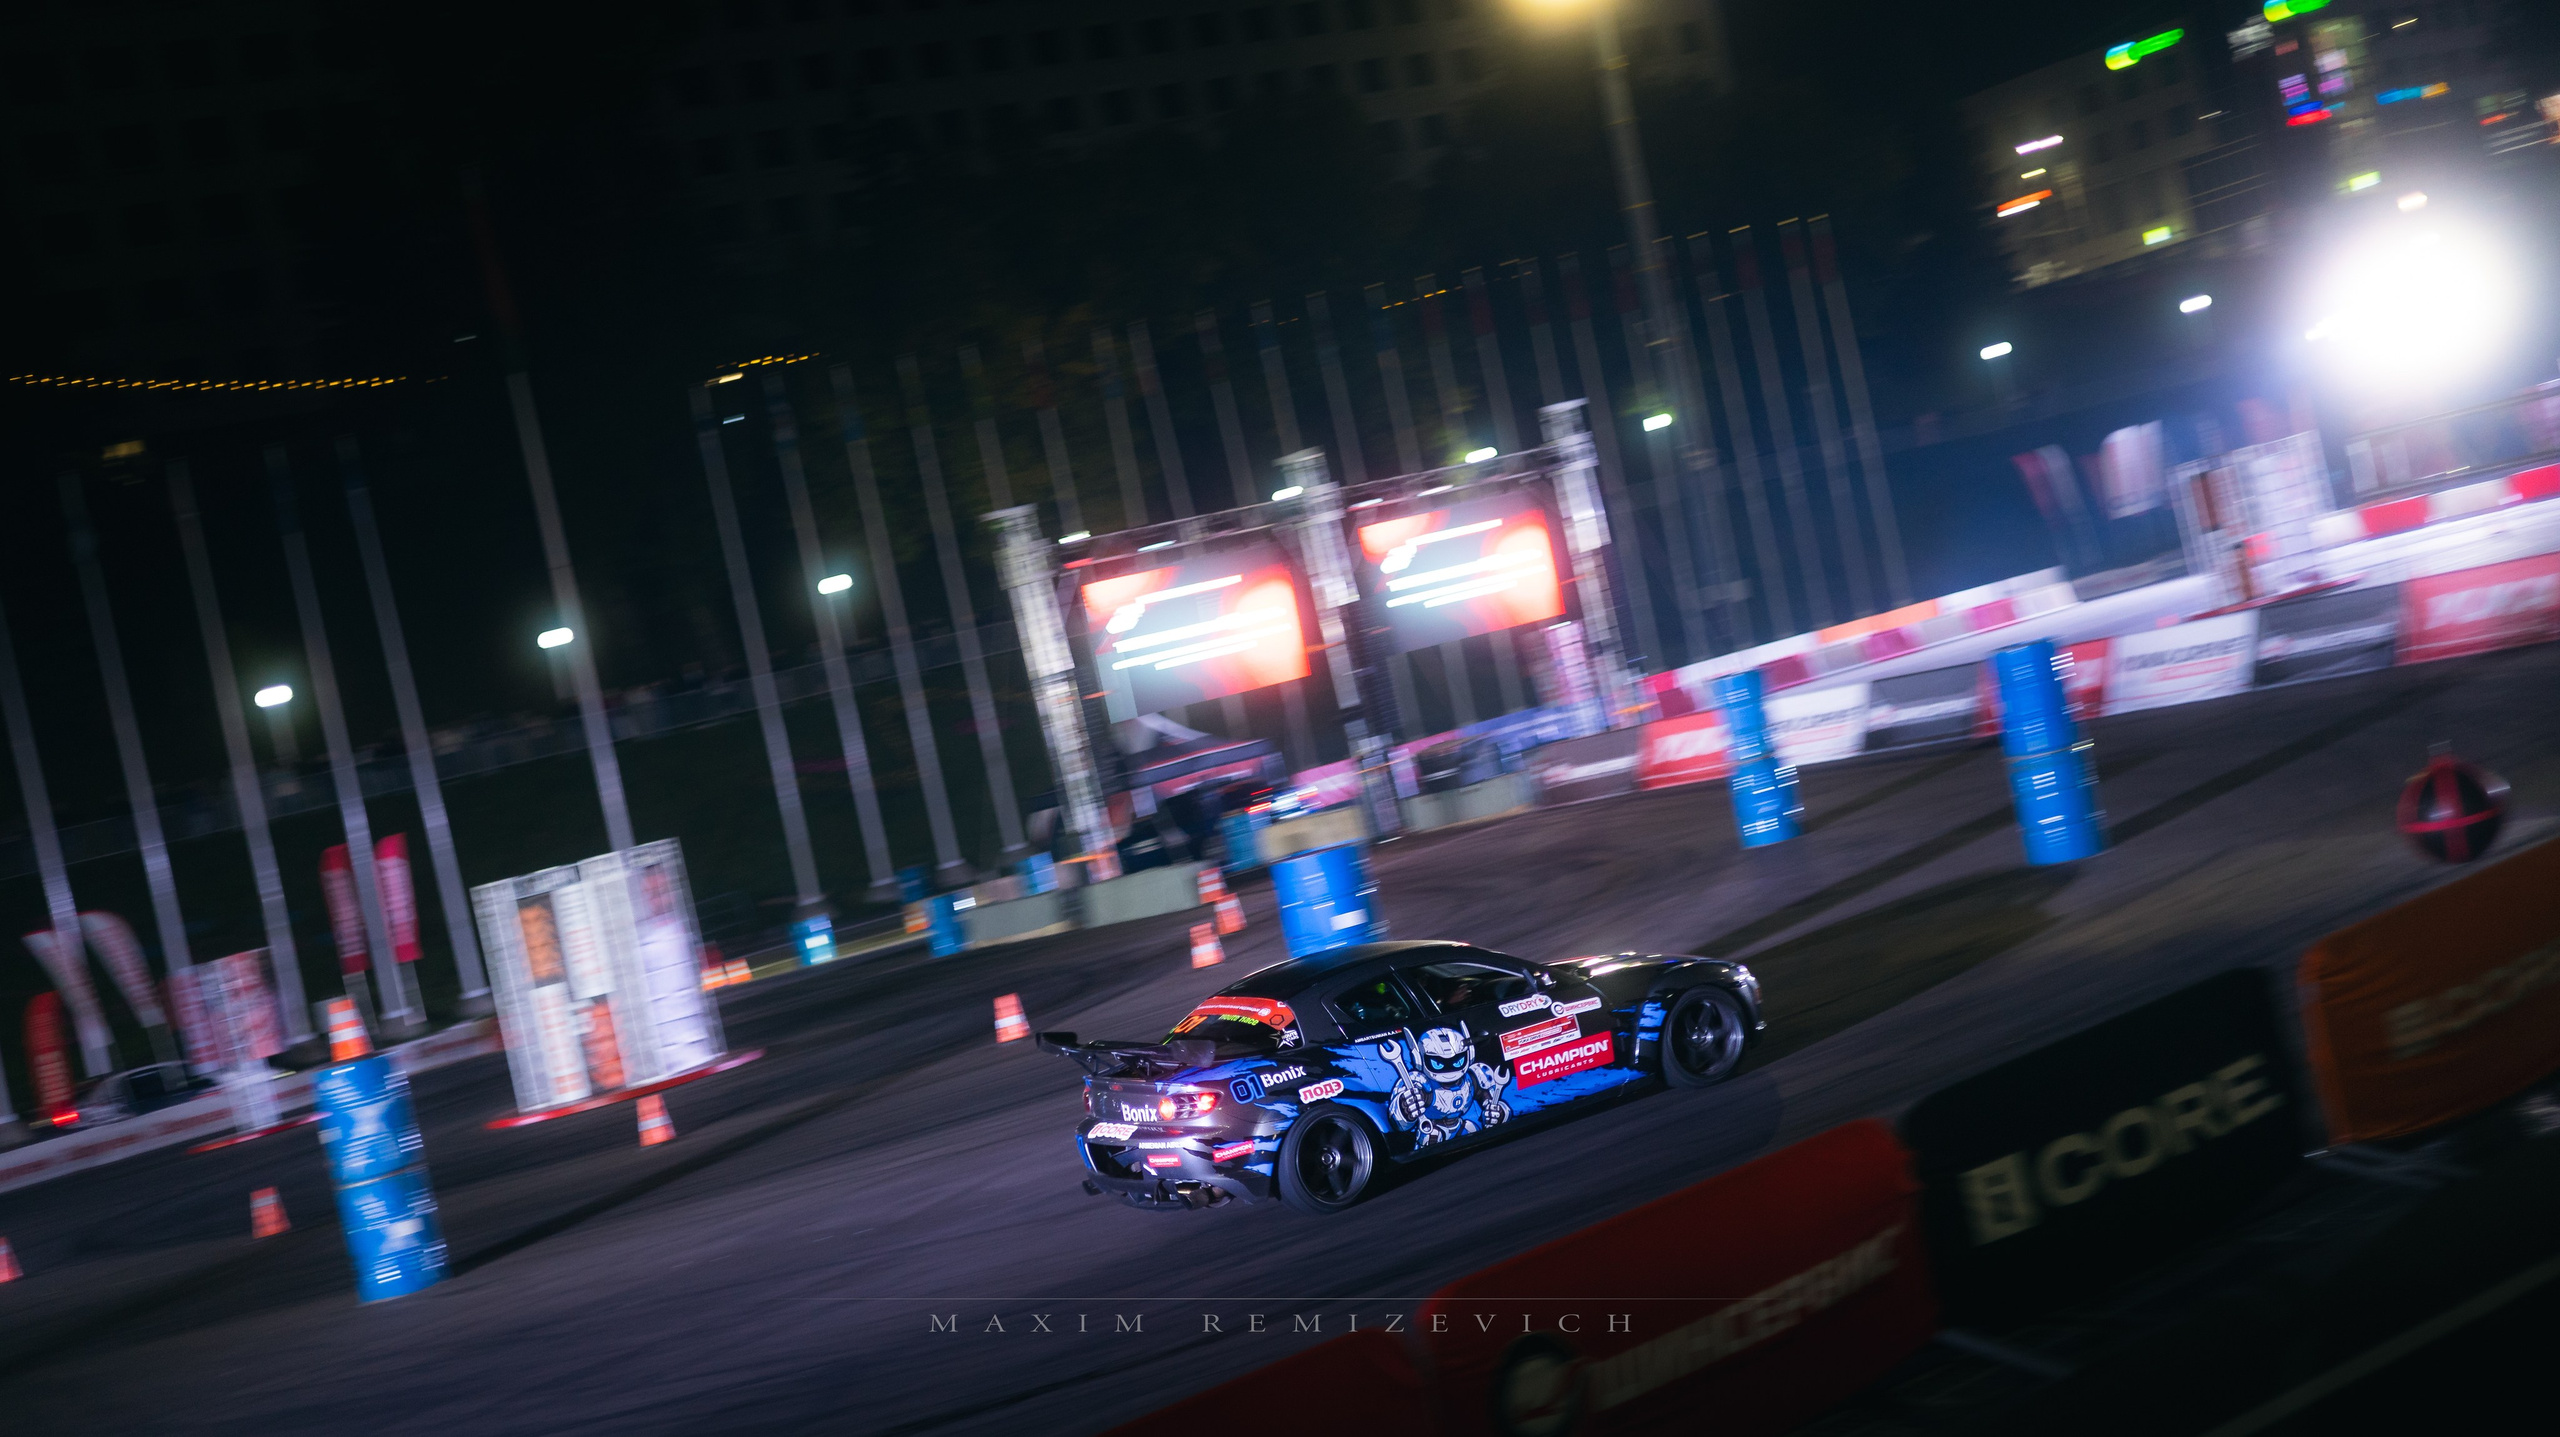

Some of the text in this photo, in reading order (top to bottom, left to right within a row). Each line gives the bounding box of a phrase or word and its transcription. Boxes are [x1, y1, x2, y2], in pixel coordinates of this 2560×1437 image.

[1501, 999, 1539, 1015] DRYDRY
[1174, 1015, 1208, 1033] 01
[1520, 1040, 1608, 1076] CHAMPION
[1537, 1058, 1594, 1079] LUBRICANTS
[1229, 1066, 1307, 1104] 01 Bonix
[1121, 1103, 1158, 1122] Bonix
[1215, 1144, 1252, 1159] CHAMPION
